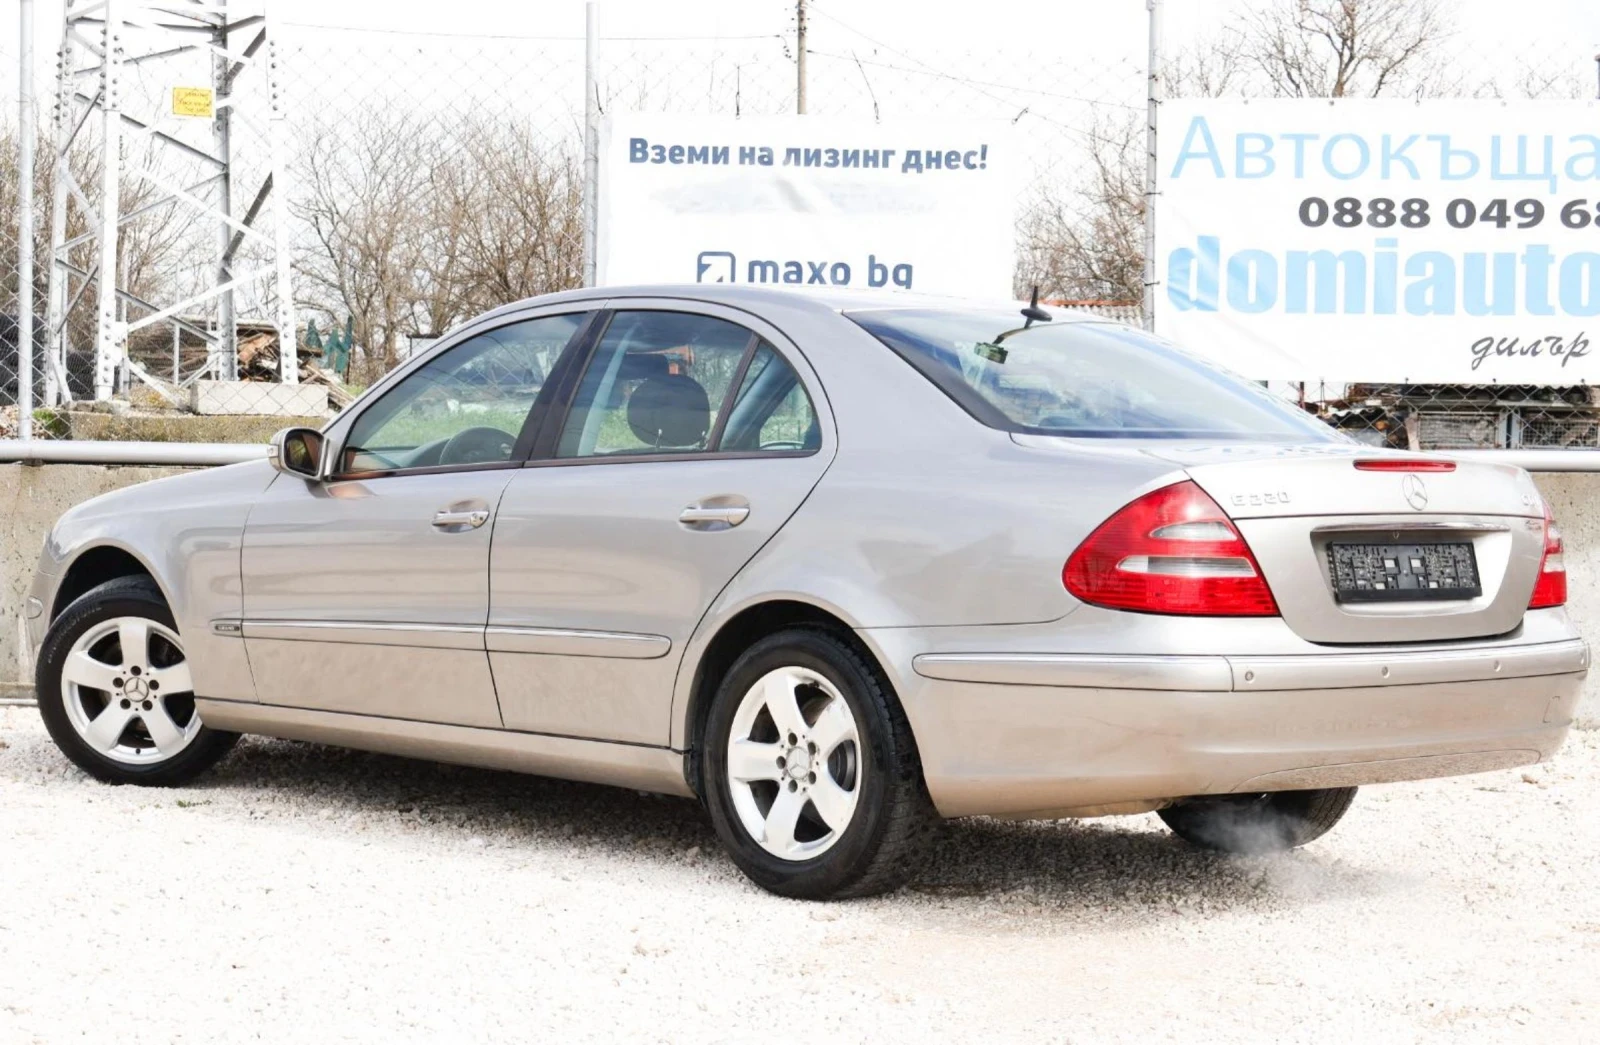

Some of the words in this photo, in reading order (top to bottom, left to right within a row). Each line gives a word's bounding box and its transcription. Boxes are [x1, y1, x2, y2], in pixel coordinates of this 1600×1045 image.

[629, 137, 730, 165] Вземи
[738, 146, 774, 167] на
[783, 147, 896, 169] лизинг
[901, 144, 988, 174] днес!
[1170, 115, 1600, 195] Автокъща
[1298, 196, 1431, 229] 0888
[1445, 198, 1545, 229] 049
[1560, 198, 1600, 229] 6
[1166, 235, 1600, 317] domiauto
[1471, 331, 1591, 371] дилър
